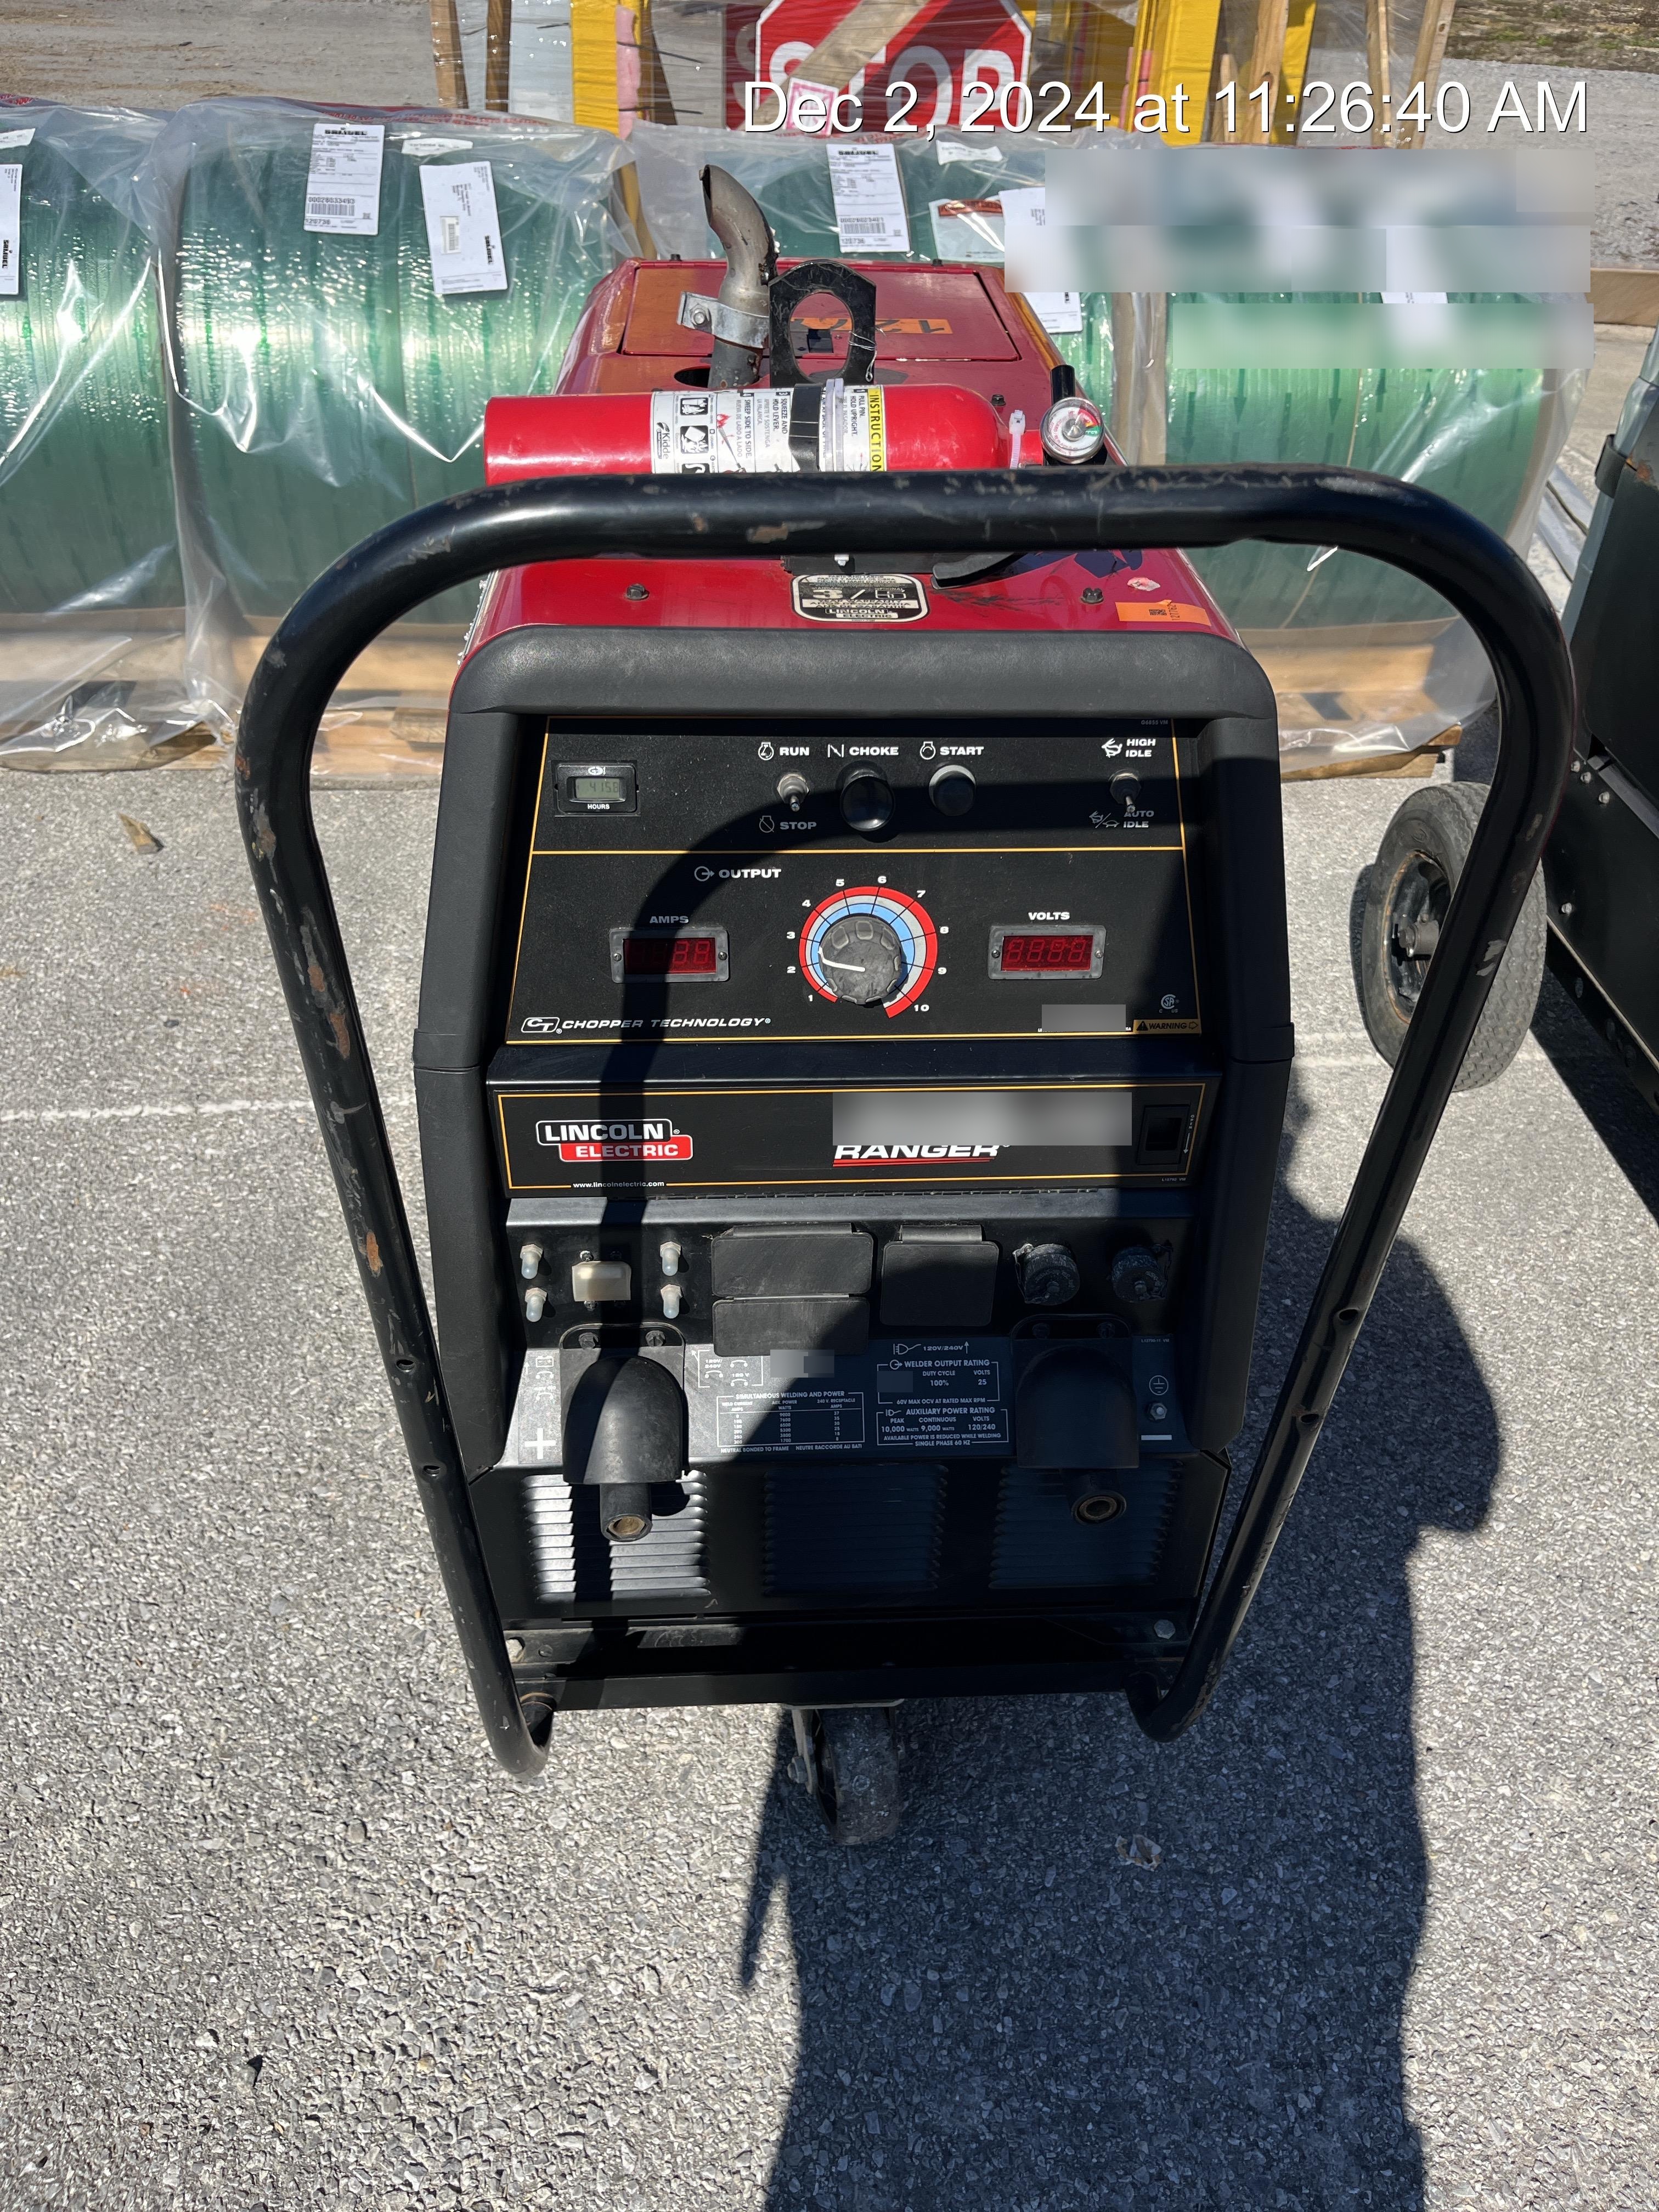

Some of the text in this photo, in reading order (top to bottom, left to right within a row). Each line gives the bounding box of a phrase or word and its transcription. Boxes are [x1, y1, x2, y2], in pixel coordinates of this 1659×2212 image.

[745, 431, 751, 439] TO
[812, 590, 843, 599] 3
[779, 747, 810, 756] RUN
[849, 747, 899, 755] CHOKE
[940, 746, 984, 755] START
[780, 822, 817, 830] STOP
[719, 868, 781, 878] OUTPUT
[1028, 912, 1070, 920] VOLTS
[562, 1019, 642, 1029] CHOPPER
[545, 1124, 664, 1142] LINCOLN
[575, 1144, 679, 1158] ELECTRIC
[834, 1146, 999, 1160] RANGER
